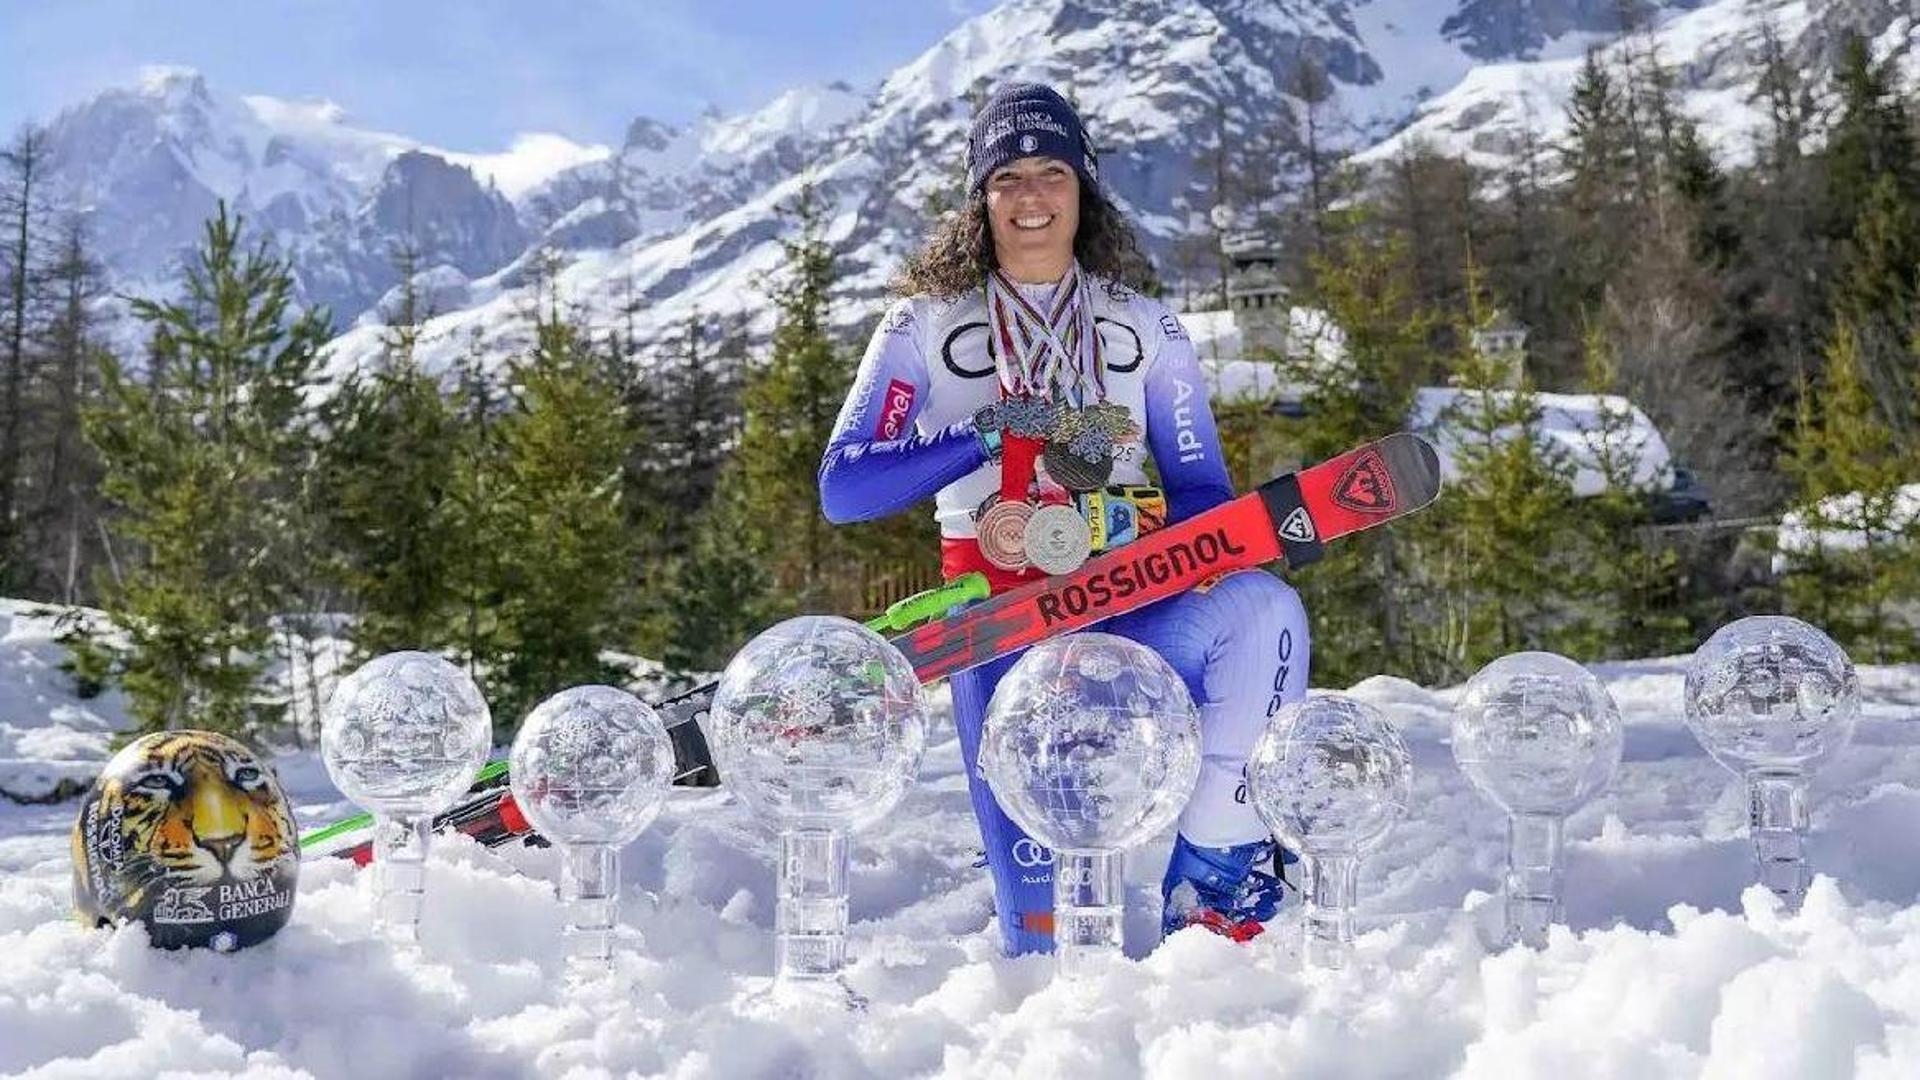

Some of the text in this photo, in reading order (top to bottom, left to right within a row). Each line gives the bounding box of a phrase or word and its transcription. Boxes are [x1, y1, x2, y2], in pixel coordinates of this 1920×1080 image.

[884, 386, 913, 439] enel
[1173, 379, 1205, 463] Audi
[1035, 528, 1245, 627] ROSSIGNOL
[219, 876, 276, 904] BANCA
[1021, 873, 1054, 884] Audi
[219, 888, 291, 921] GENERALI
